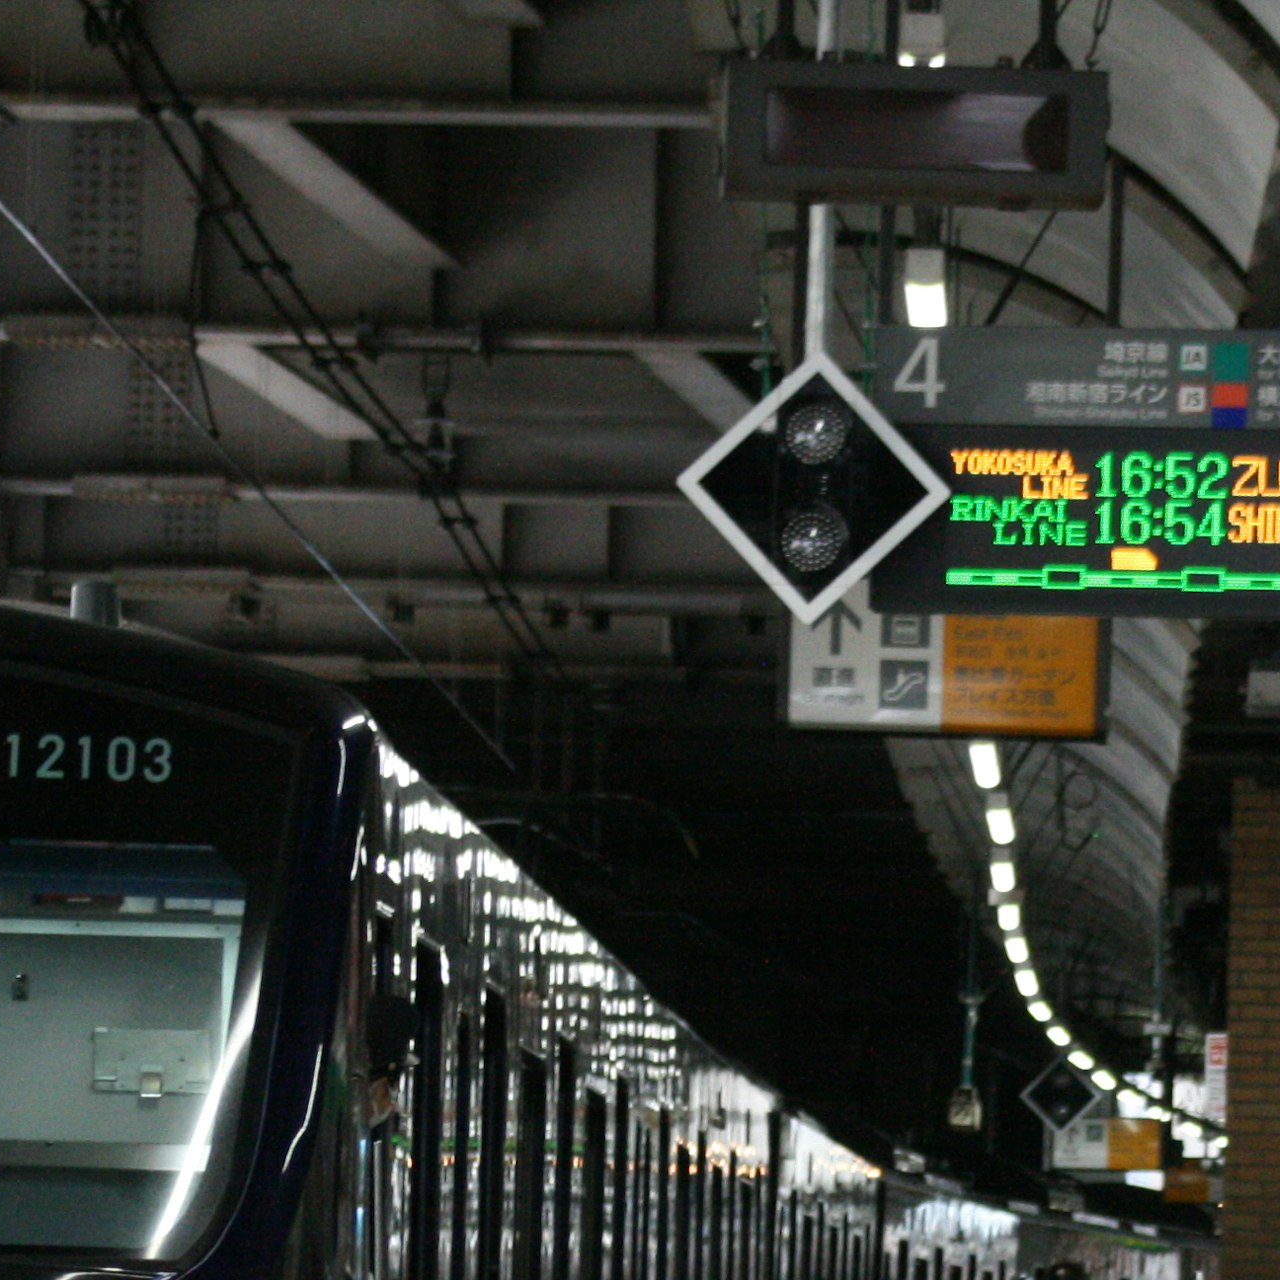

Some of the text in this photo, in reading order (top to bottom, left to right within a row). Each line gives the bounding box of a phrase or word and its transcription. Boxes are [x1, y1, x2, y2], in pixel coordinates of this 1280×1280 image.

[893, 336, 946, 408] 4
[950, 448, 1074, 476] YOKOSUKA
[1095, 451, 1230, 499] 16:52
[1022, 473, 1089, 499] LINE
[949, 495, 1068, 522] RINKAI
[1094, 499, 1226, 546] 16:54
[992, 520, 1088, 546] LINE
[6, 733, 173, 783] 12103
